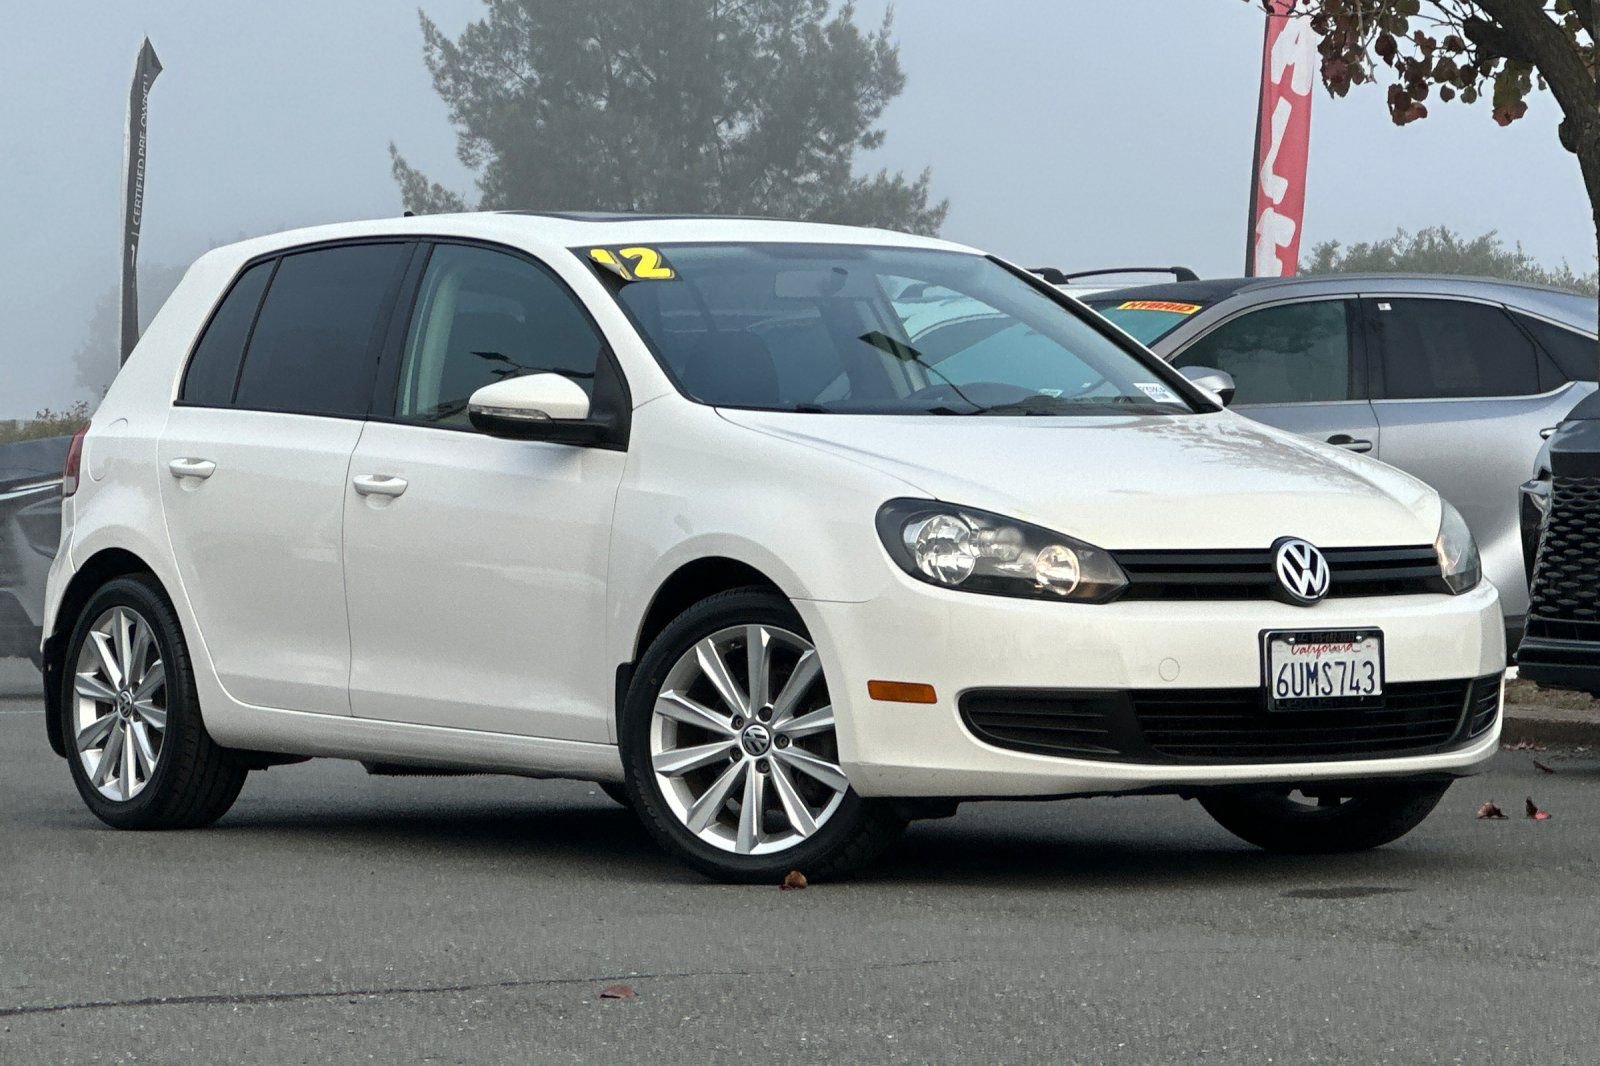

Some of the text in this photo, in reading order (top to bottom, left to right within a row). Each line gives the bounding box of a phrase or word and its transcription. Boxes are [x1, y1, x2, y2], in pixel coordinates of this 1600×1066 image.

[132, 158, 145, 226] CERTIFIED
[589, 246, 674, 280] 12
[1124, 301, 1196, 312] HYBRID
[1291, 642, 1361, 659] California
[1276, 660, 1375, 697] 6UMS743
